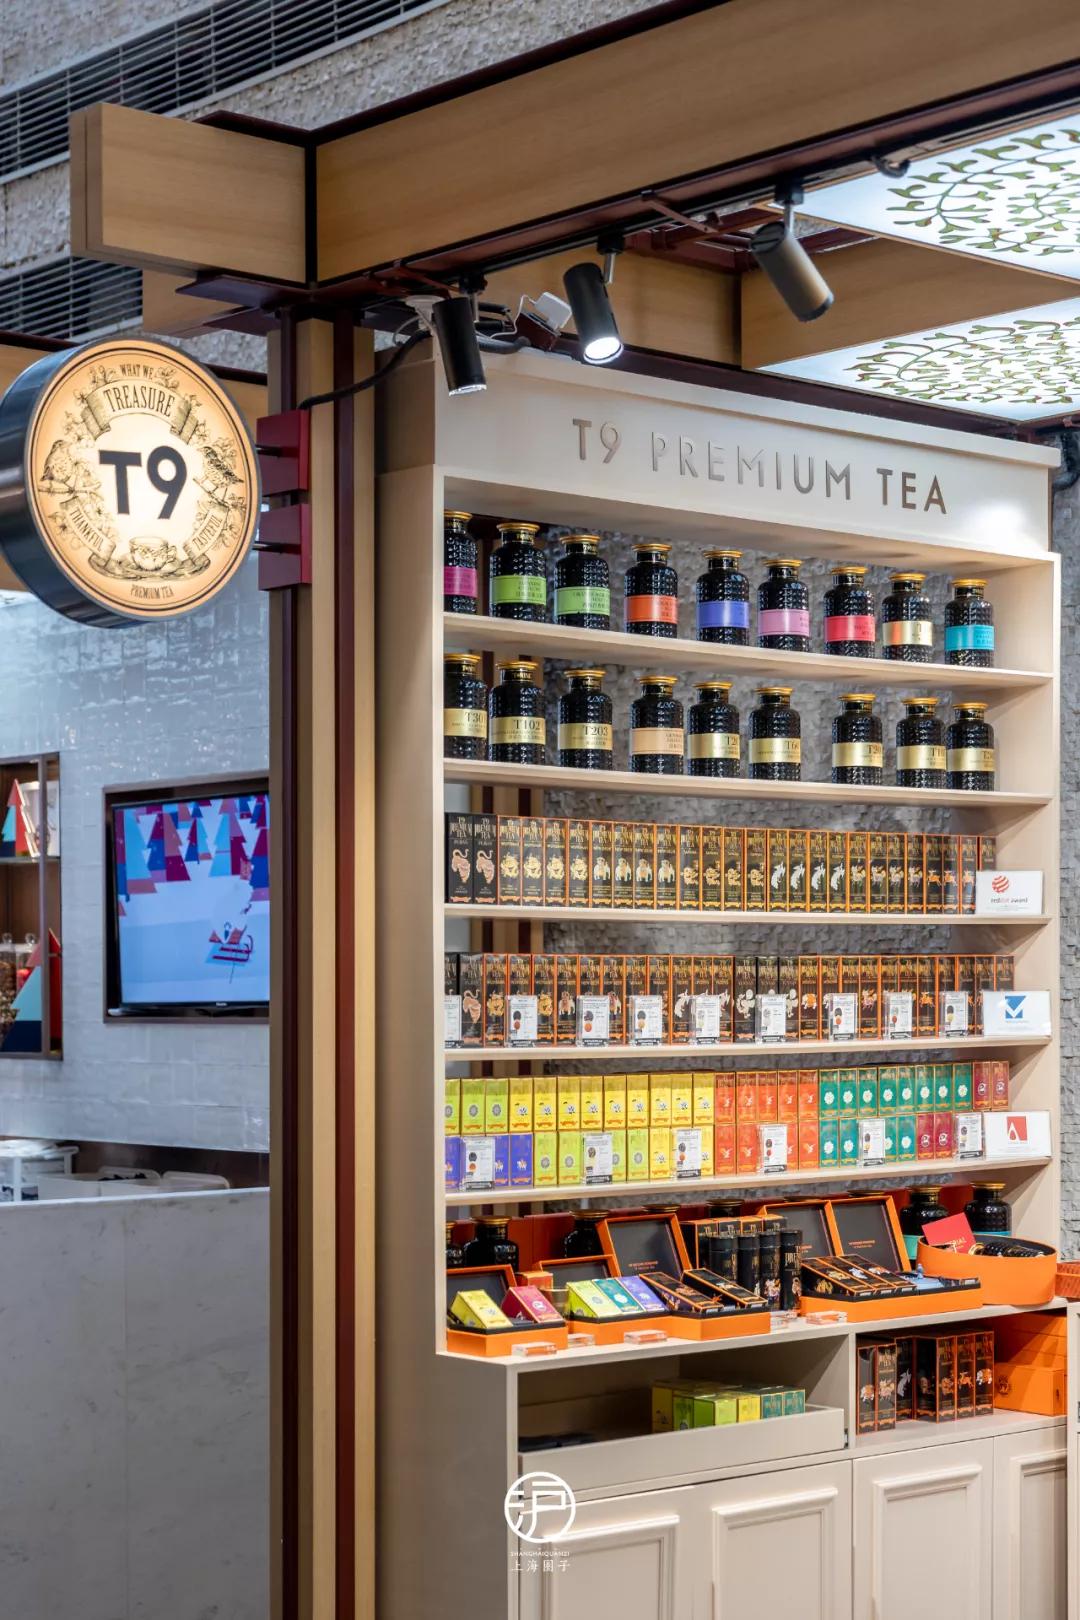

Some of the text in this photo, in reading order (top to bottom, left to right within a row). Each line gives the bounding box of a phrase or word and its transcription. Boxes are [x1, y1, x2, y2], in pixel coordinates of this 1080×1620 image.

[120, 364, 154, 380] WHAT WE
[103, 385, 175, 417] TREASURE
[572, 418, 948, 515] T9 PREMIUM TEA
[97, 445, 188, 521] T9
[70, 509, 104, 552] THANKFUL
[191, 514, 223, 551] TASTEFUL
[130, 584, 175, 599] PREMIUM TEA
[513, 719, 541, 731] T102
[582, 725, 609, 737] T203
